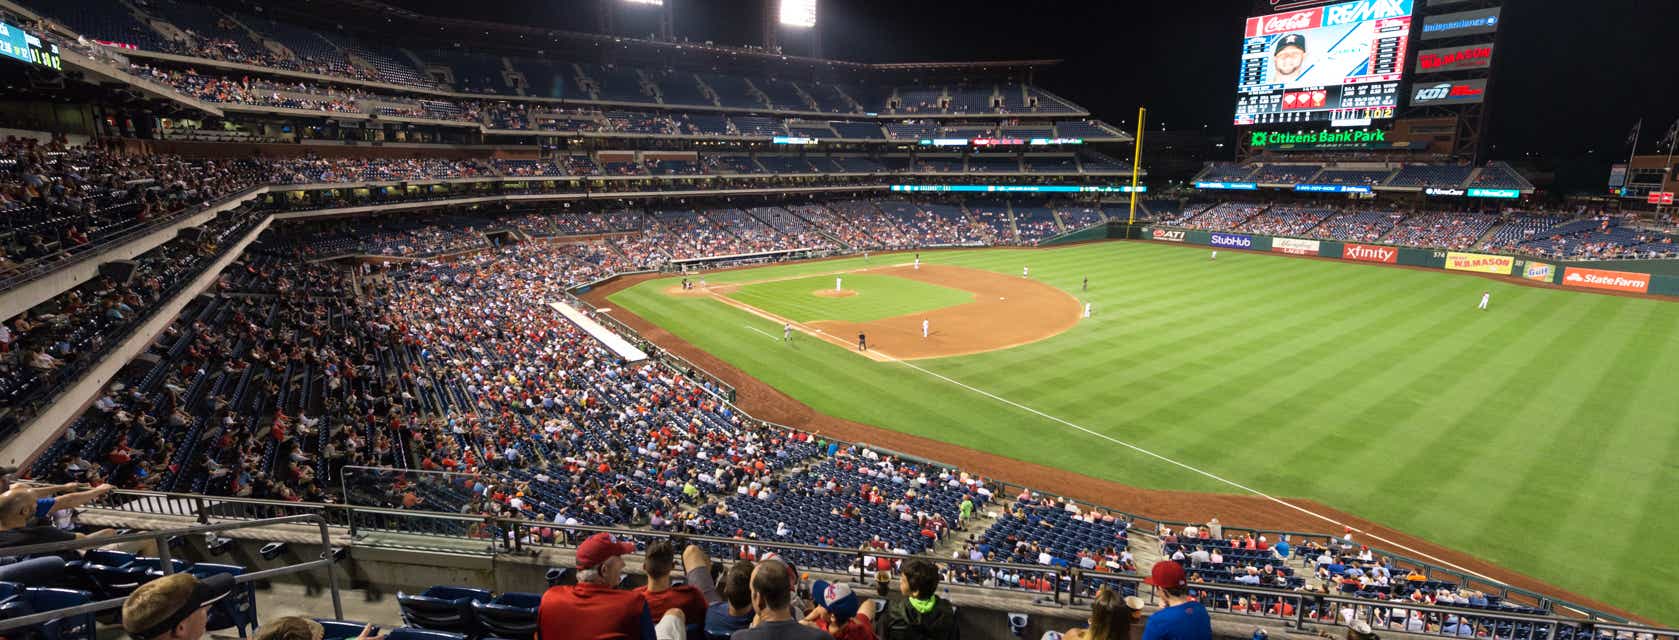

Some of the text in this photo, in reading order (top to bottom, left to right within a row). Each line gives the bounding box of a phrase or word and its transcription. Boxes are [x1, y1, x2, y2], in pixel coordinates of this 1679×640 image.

[1269, 129, 1385, 144] Citizens Bank Park
[1163, 230, 1186, 240] ATI
[1211, 234, 1251, 248] StubHub
[1346, 246, 1393, 262] xfinity
